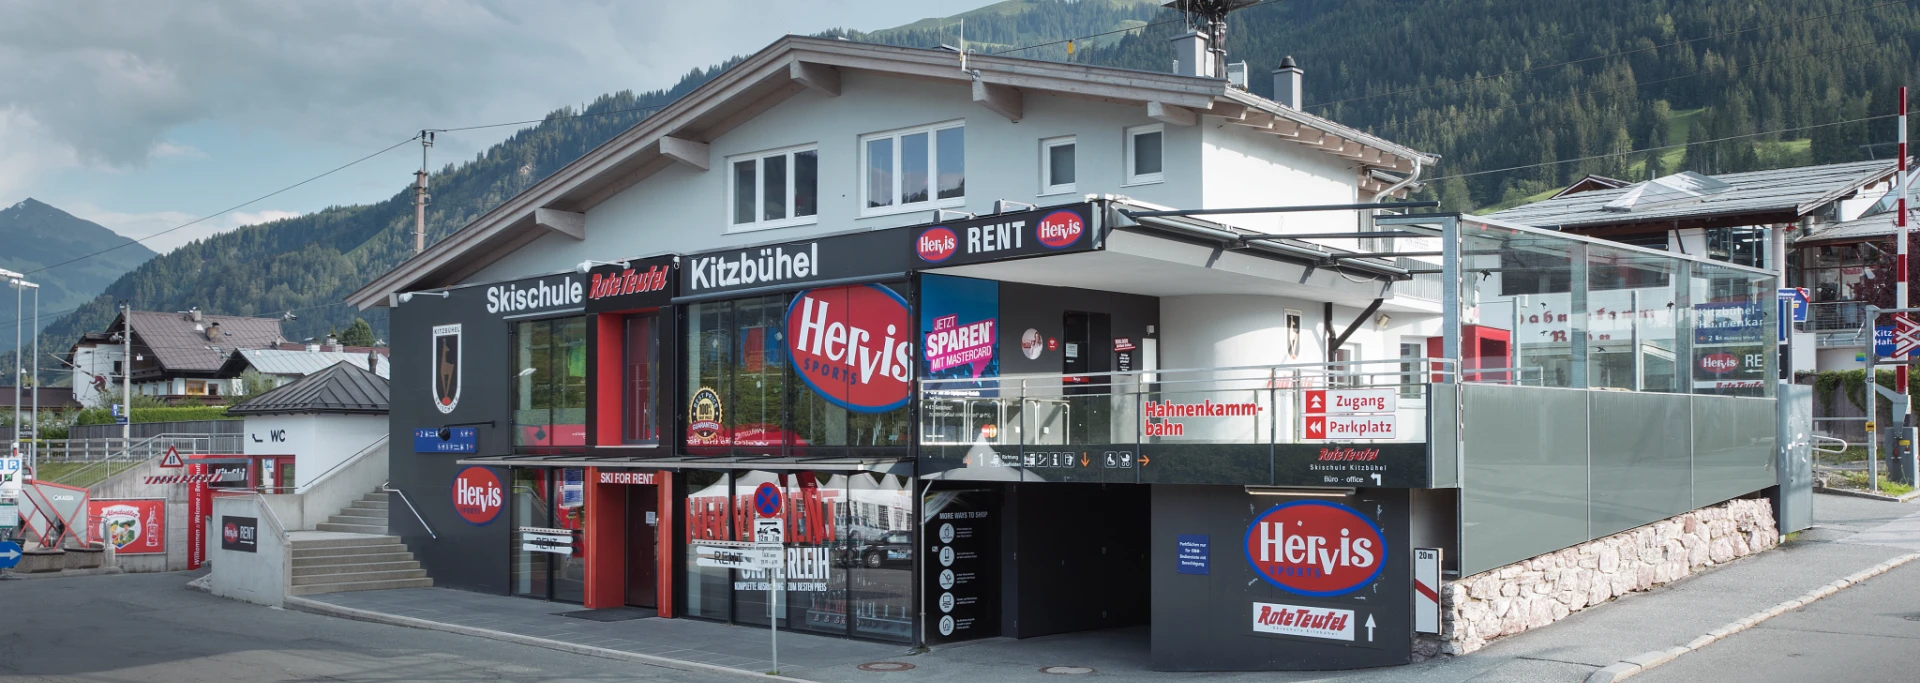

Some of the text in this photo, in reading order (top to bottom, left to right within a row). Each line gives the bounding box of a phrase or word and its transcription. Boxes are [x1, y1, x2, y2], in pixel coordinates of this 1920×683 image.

[967, 220, 1026, 254] RENT
[1041, 219, 1080, 240] Hervis
[920, 235, 955, 255] Hervis
[691, 242, 818, 291] Kitzbühel
[486, 276, 583, 314] Skischule
[1698, 305, 1761, 318] Kitzbühel-
[934, 315, 956, 331] JETZT
[433, 326, 461, 336] KITZBÜHEL
[797, 296, 914, 385] Hervis
[931, 356, 945, 370] MIT
[946, 345, 992, 367] MASTERCARD
[1703, 358, 1736, 369] Hervis
[803, 357, 857, 386] SPORTS
[693, 391, 719, 408] BEST PRICE
[1336, 394, 1386, 411] Zugang
[1144, 398, 1264, 418] Hahnenkamm-
[692, 421, 719, 431] GUARANTEED
[1145, 418, 1184, 437] bahn
[1329, 420, 1392, 437] Parkplatz
[270, 429, 286, 443] WC
[420, 430, 424, 438] 2
[978, 452, 984, 467] 1
[1309, 463, 1346, 471] Skischule
[600, 472, 654, 485] SKI FOR RENT
[1323, 475, 1339, 483] Büro
[1346, 475, 1364, 483] office
[457, 478, 502, 513] Hervis
[939, 511, 954, 520] MORE
[954, 511, 968, 519] WAYS
[224, 525, 255, 540] Hervis RENT
[536, 537, 558, 550] RENT
[1260, 520, 1375, 576] Hervis
[714, 550, 743, 567] RENT
[1418, 551, 1434, 560] 20 m
[1268, 564, 1322, 579] SPORTS
[734, 581, 757, 591] KOMPLETTE
[787, 582, 797, 591] ZUM
[797, 582, 814, 592] BESTEN
[814, 582, 827, 592] PREIS
